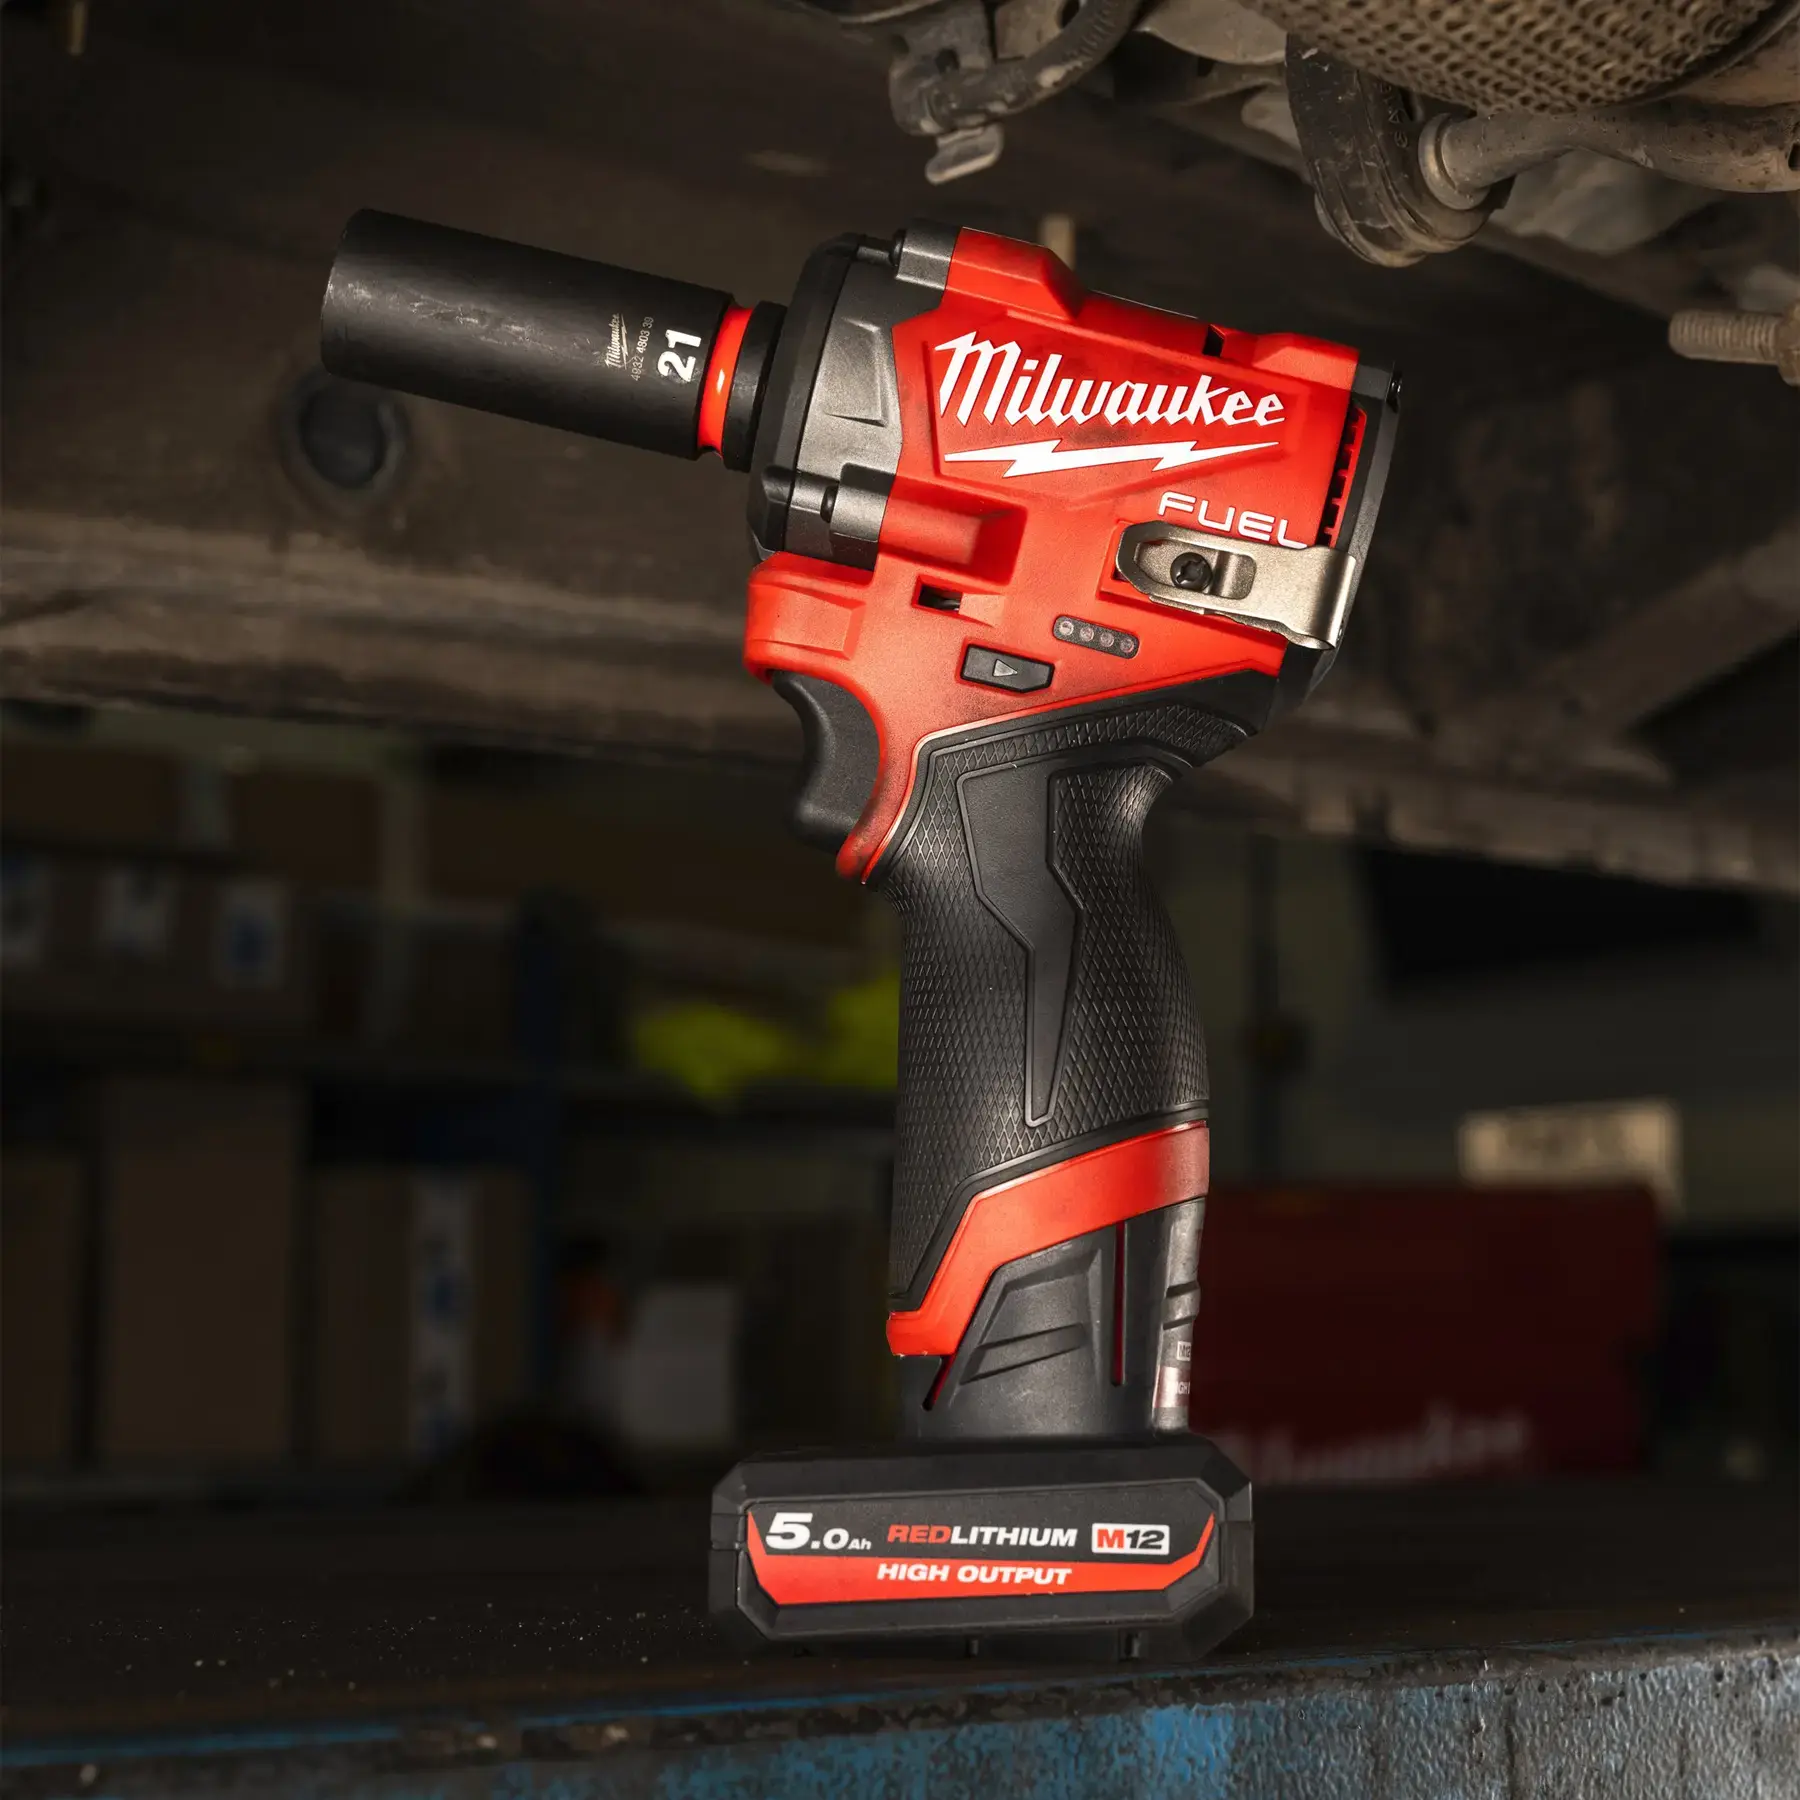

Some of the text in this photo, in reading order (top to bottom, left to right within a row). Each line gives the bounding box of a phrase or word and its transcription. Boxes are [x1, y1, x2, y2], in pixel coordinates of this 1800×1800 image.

[604, 313, 621, 368] Milwaukee
[631, 316, 654, 381] 4932 4803 39
[658, 329, 702, 382] 21
[934, 331, 1285, 427] Milwaukee
[1158, 490, 1308, 549] FUEL
[887, 1525, 1078, 1548] REDLITHIUM
[1096, 1527, 1166, 1550] M12
[877, 1563, 1073, 1586] HIGH OUTPUT
